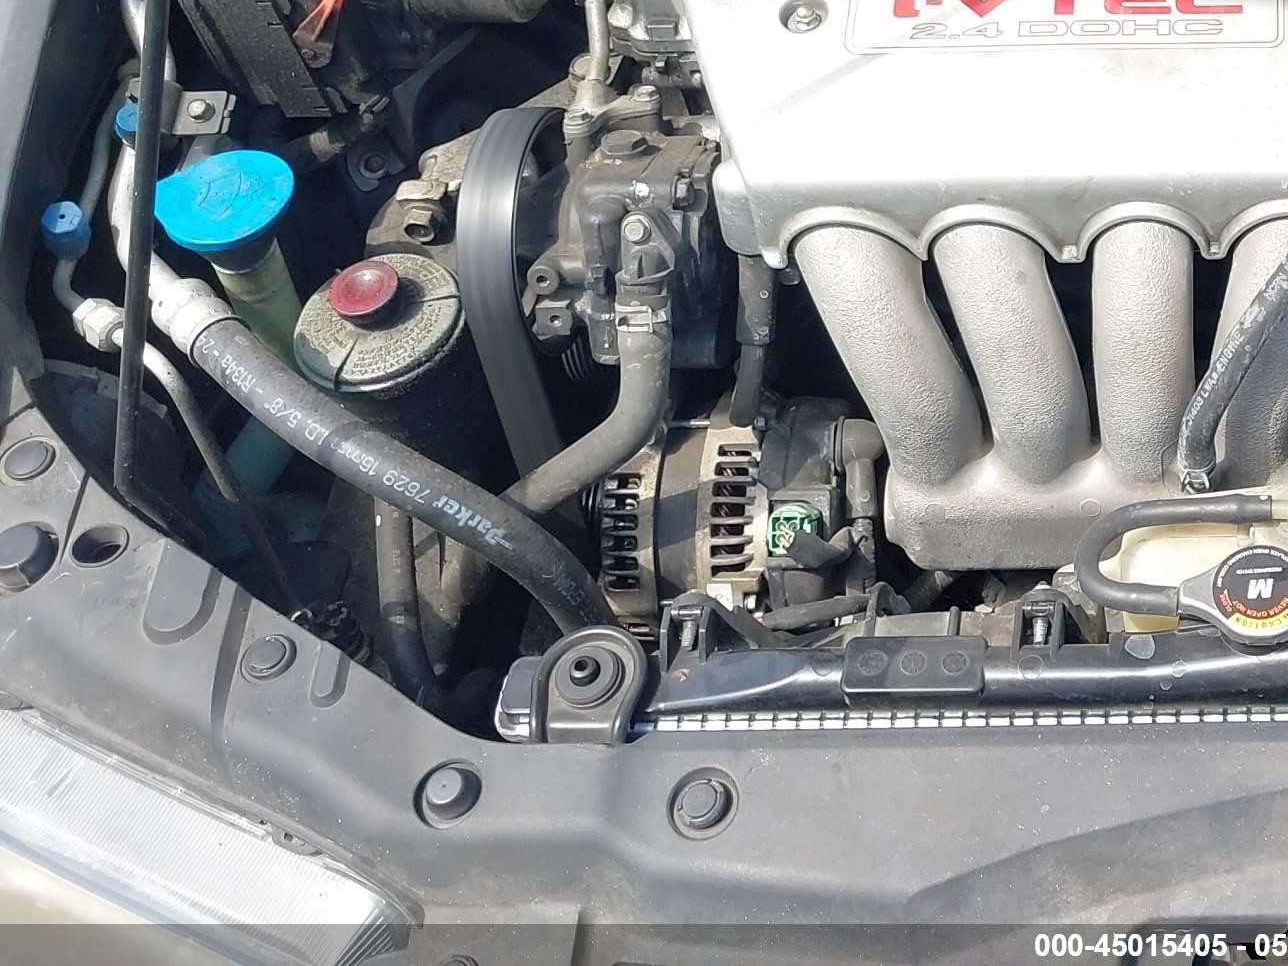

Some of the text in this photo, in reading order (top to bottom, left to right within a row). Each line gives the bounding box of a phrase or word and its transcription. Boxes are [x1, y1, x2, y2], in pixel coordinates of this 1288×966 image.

[910, 19, 1223, 40] 2.4 DOHC
[221, 355, 257, 394] R134a
[383, 469, 431, 504] 7629
[433, 495, 513, 550] Parker
[1247, 578, 1274, 599] M
[1219, 593, 1232, 612] CLOSE
[1232, 600, 1246, 613] HOT
[1247, 608, 1268, 617] OPEN
[1235, 616, 1283, 629] CAUTION
